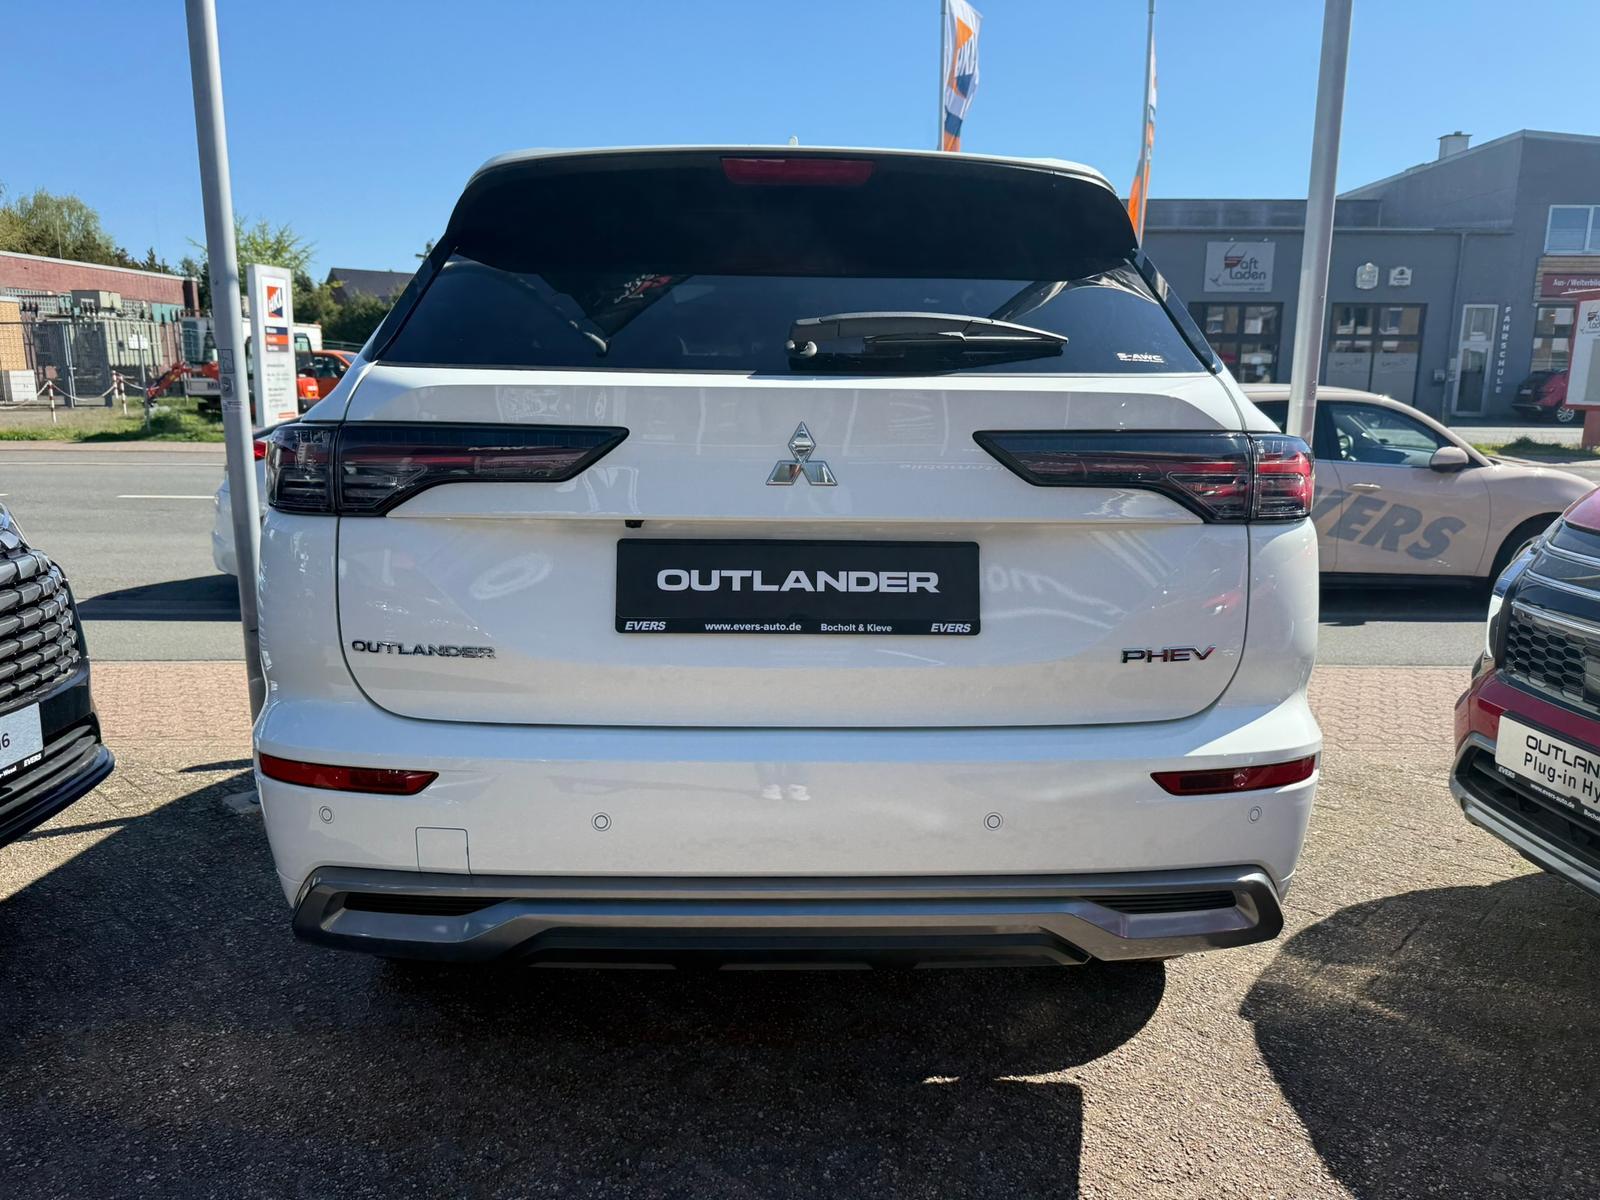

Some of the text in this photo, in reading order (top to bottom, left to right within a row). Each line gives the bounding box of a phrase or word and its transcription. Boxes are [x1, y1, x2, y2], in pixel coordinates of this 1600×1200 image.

[1496, 306, 1511, 393] FAHRSCHULE
[1311, 485, 1467, 560] VERS
[656, 569, 940, 593] OUTLANDER
[624, 621, 666, 632] EVERS
[705, 622, 802, 632] www.evers-auto.de
[820, 623, 893, 632] Bocholt & Kleve
[930, 623, 972, 633] EVERS
[351, 640, 496, 658] OUTLANDER
[1122, 645, 1216, 663] PHEV
[24, 753, 42, 767] EVERS
[1523, 752, 1577, 789] Plug-in
